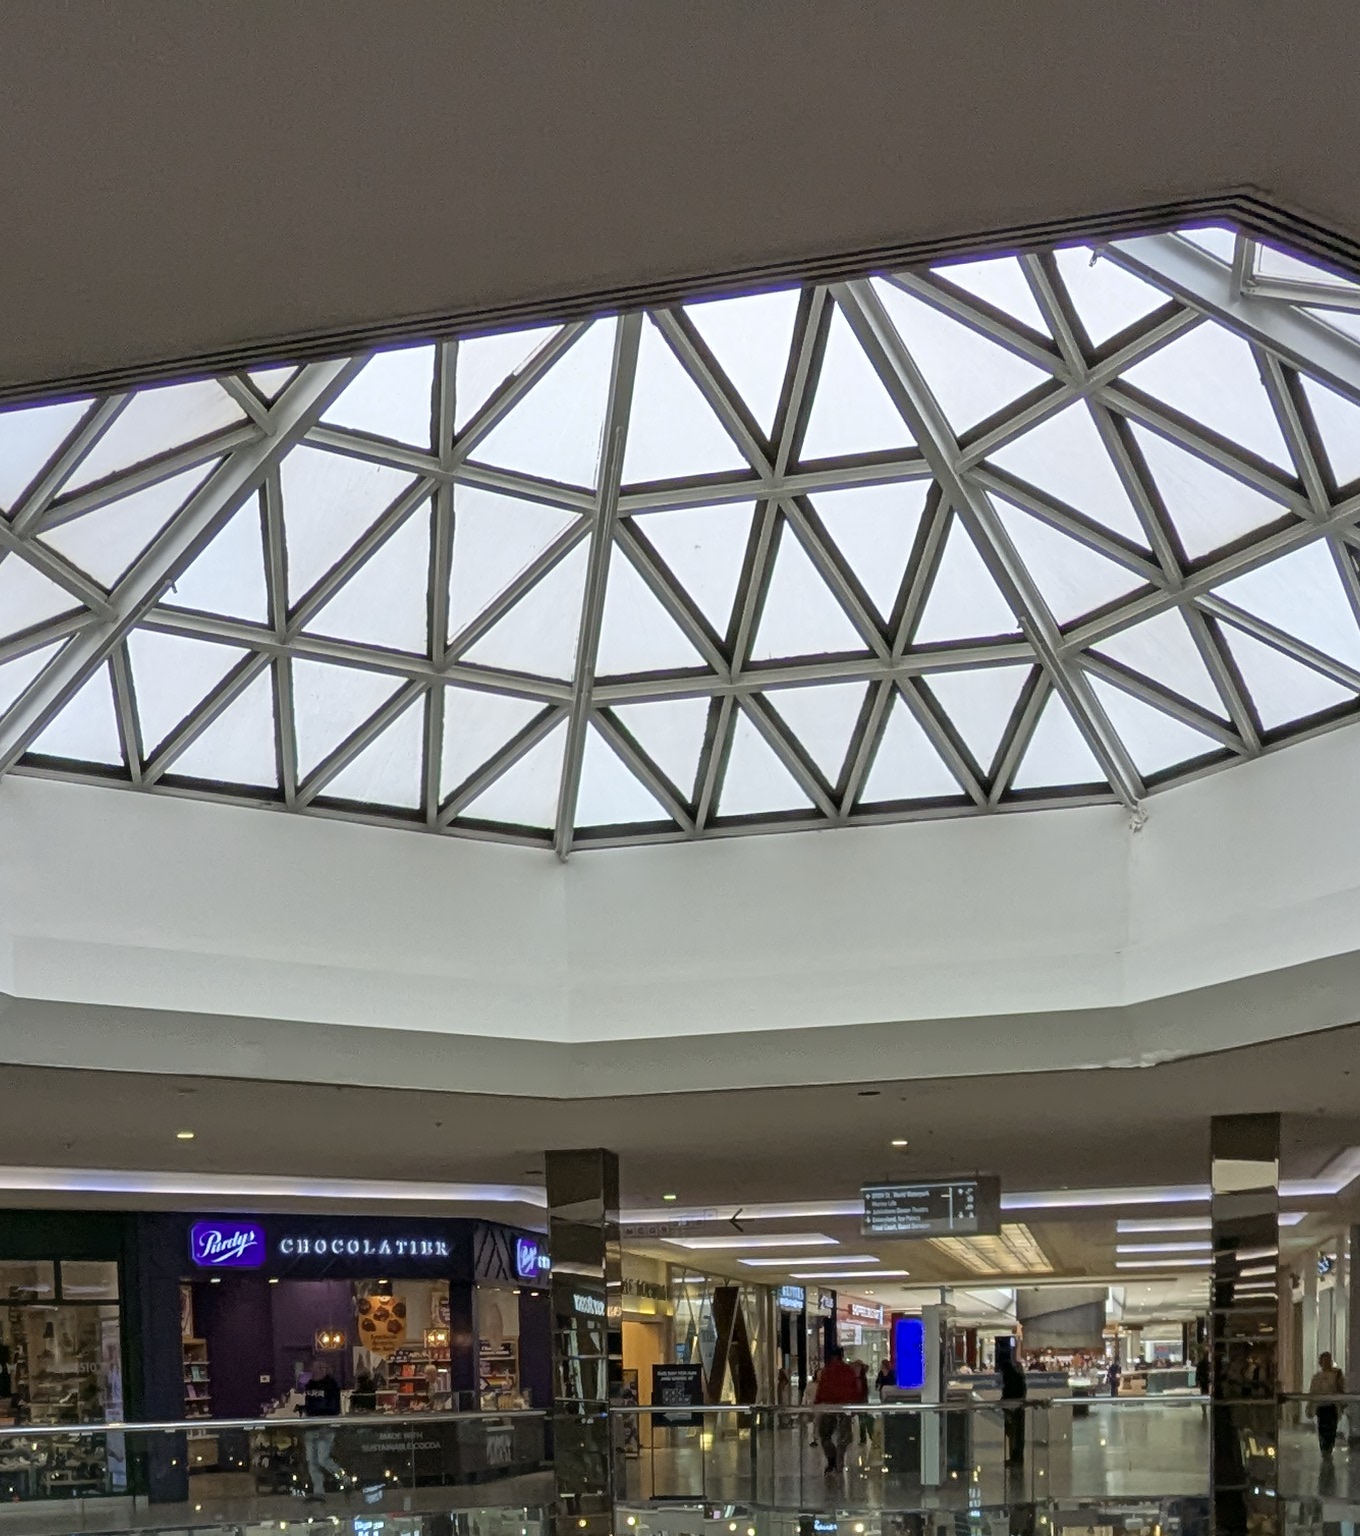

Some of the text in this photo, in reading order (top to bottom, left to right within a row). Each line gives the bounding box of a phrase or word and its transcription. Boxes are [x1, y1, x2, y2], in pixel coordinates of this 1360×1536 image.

[196, 1230, 258, 1263] Purdys
[279, 1237, 450, 1257] CHOCOLATIER
[379, 1431, 423, 1440] MADE WITH
